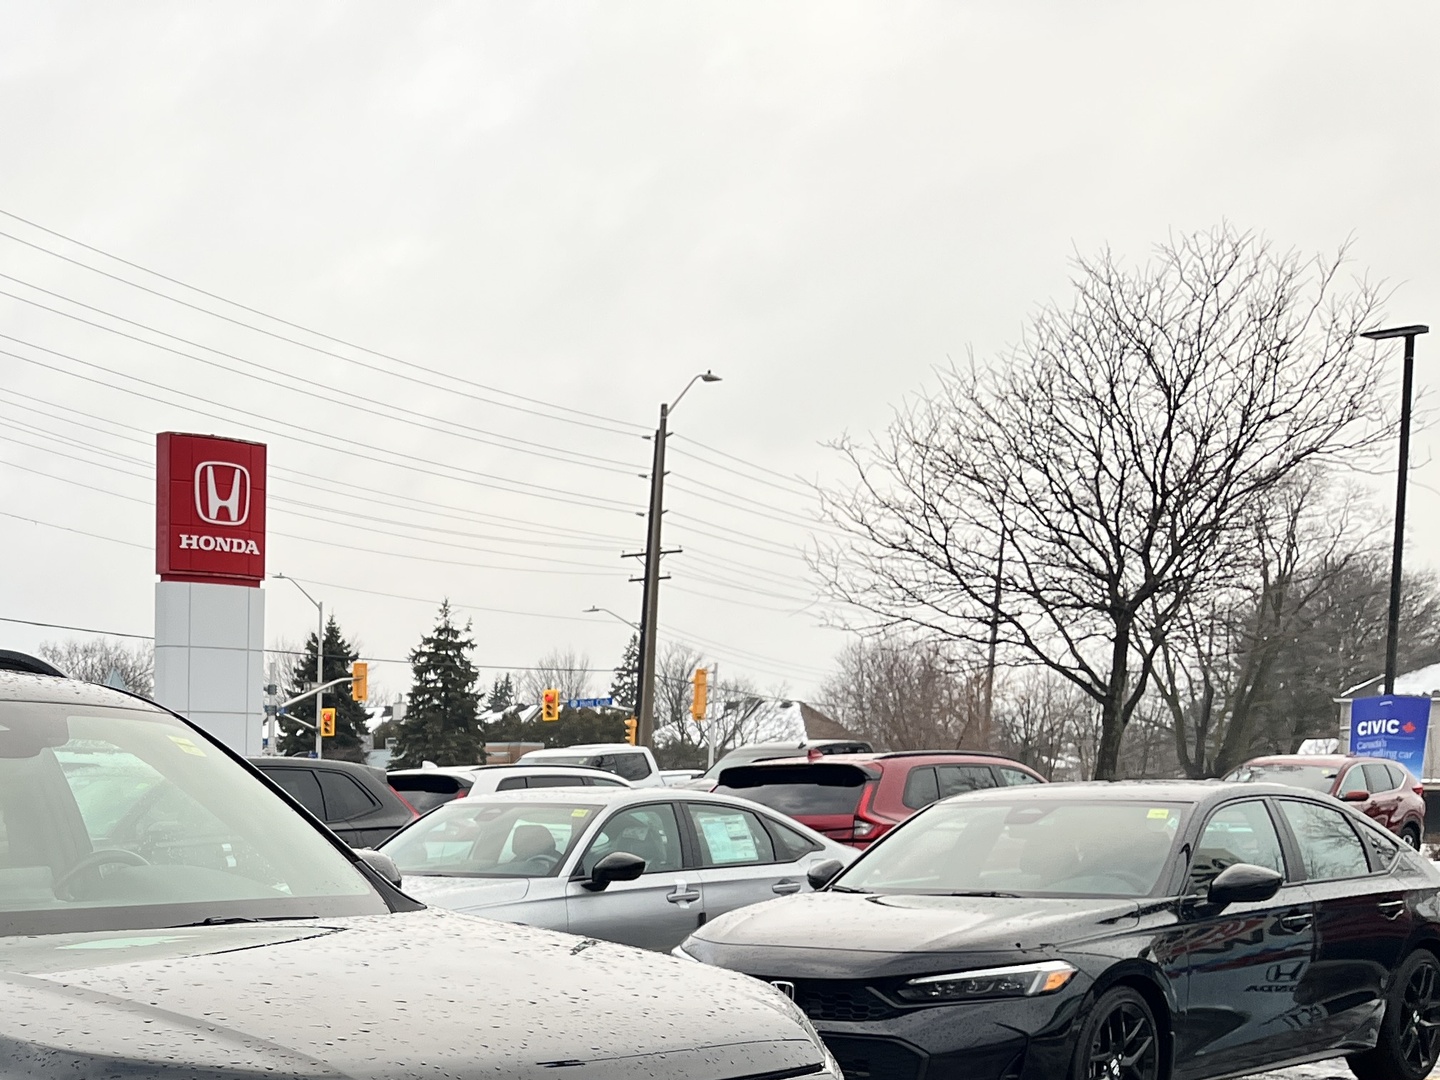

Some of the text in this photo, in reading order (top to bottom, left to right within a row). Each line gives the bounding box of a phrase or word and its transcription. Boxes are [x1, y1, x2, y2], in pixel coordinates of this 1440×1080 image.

[179, 534, 260, 555] HONDA
[1357, 719, 1400, 736] CIVIC
[1398, 751, 1414, 759] car
